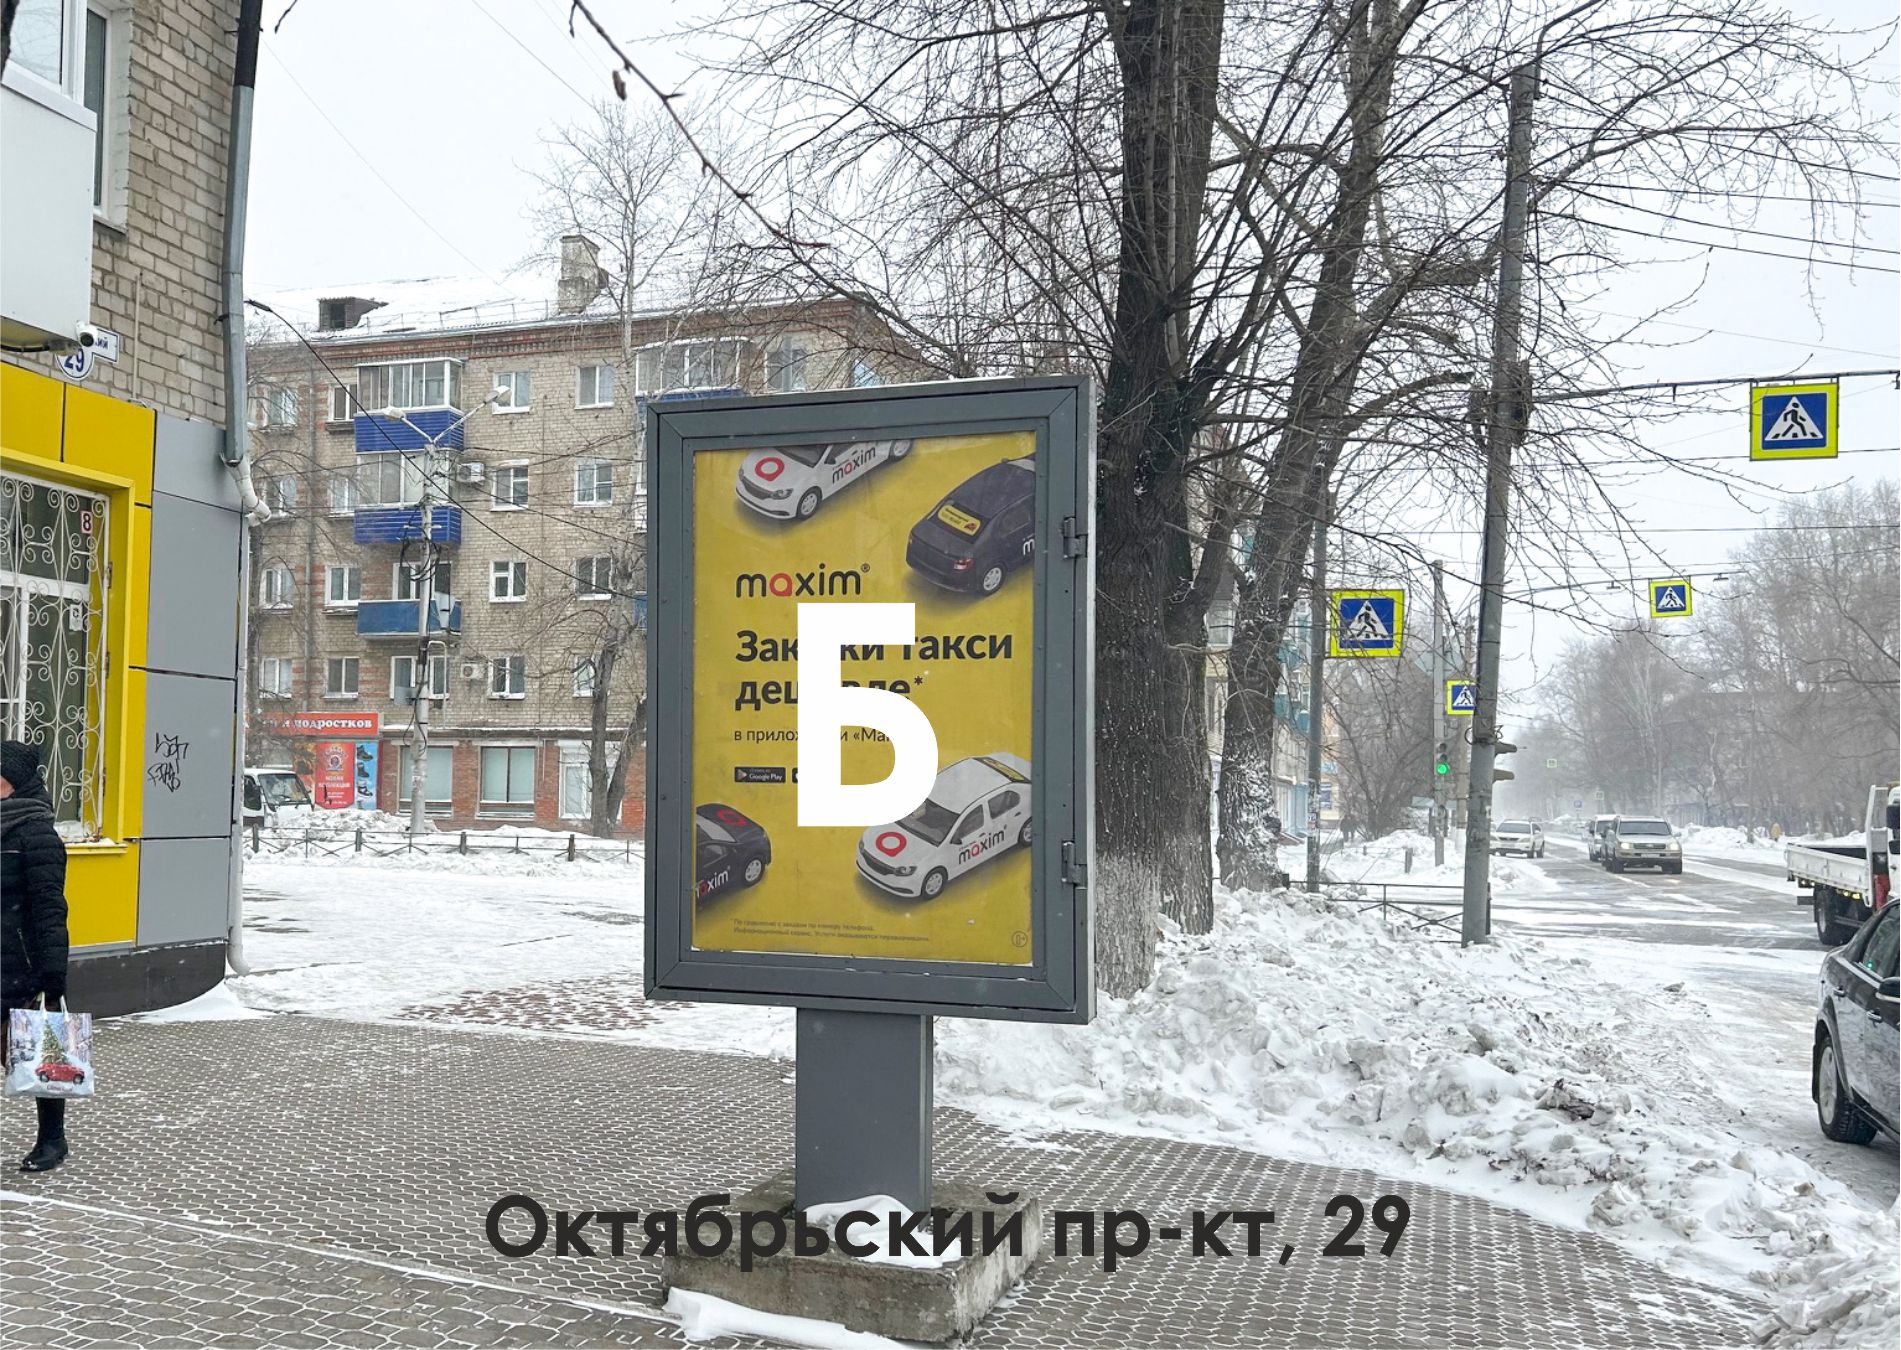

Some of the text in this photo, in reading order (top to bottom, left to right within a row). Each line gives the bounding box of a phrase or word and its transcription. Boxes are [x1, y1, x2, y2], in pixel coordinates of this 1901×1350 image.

[64, 348, 85, 373] 29
[82, 512, 92, 532] 8
[734, 730, 742, 741] в
